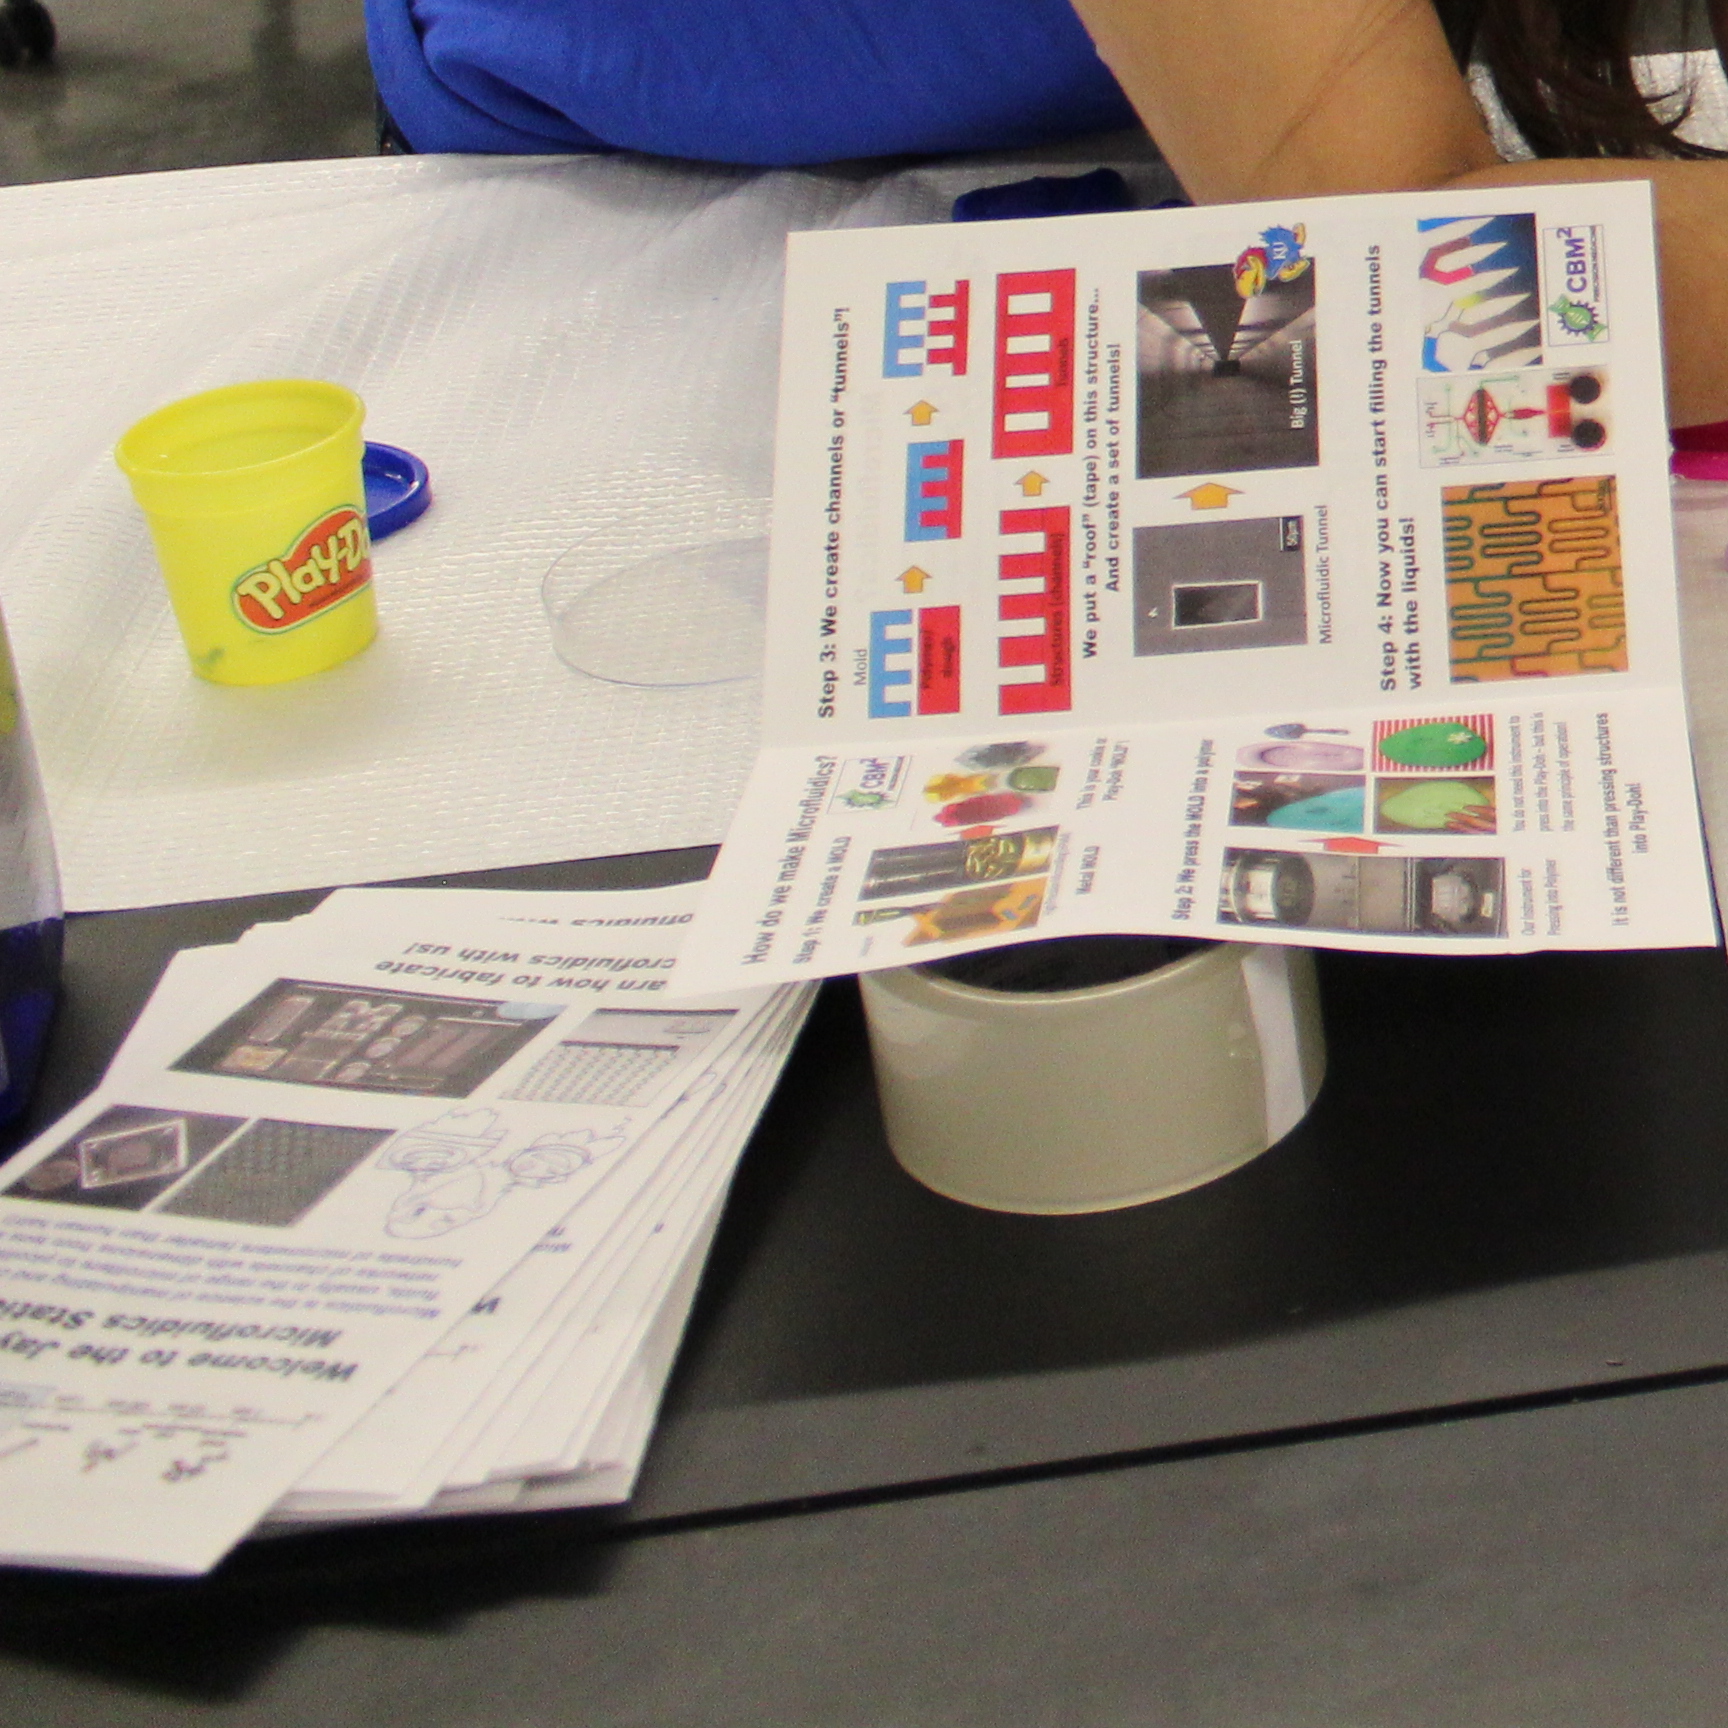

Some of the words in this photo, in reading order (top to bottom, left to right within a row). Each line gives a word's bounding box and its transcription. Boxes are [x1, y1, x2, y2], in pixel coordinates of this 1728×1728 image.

[1270, 240, 1288, 260] KU
[1365, 245, 1381, 315] tunnels
[1367, 322, 1382, 353] the
[1287, 339, 1303, 384] Tunnel
[1106, 344, 1120, 412] tunnels!
[1368, 359, 1387, 413] filling
[832, 409, 845, 428] or
[1083, 390, 1097, 422] this
[1289, 406, 1306, 428] Big
[1086, 428, 1097, 449] on
[1105, 419, 1119, 435] of
[1106, 441, 1119, 468] set
[1371, 419, 1386, 466] start
[825, 435, 843, 524] channels
[1082, 455, 1100, 507] (tape)
[1108, 474, 1119, 485] a
[1375, 473, 1388, 510] can
[1106, 491, 1119, 550] create
[1314, 504, 1328, 552] Tunnel
[1377, 517, 1394, 553] you
[236, 518, 371, 621] Play-D
[824, 531, 839, 598] create
[1399, 518, 1419, 592] liquids!
[1085, 573, 1096, 585] a
[1105, 556, 1119, 591] And
[1376, 561, 1392, 607] Now
[1083, 591, 1100, 622] put
[1316, 557, 1331, 643] Microfluidic
[820, 605, 837, 636] We
[1377, 615, 1393, 634] 4:
[1403, 600, 1419, 634] the
[819, 643, 836, 661] 3:
[1049, 609, 1063, 686] Structures
[1082, 628, 1097, 658] We
[853, 648, 868, 685] Mold
[1380, 641, 1398, 690] Step
[1404, 642, 1421, 687] with
[817, 669, 838, 717] Step
[1595, 712, 1612, 765] structures
[787, 756, 835, 842] Microfluidics?
[1189, 776, 1208, 793] into
[1599, 768, 1620, 812] pressing
[1185, 794, 1205, 821] MOLD
[1625, 782, 1646, 831] Play-Doh!
[1184, 822, 1201, 838] the
[1603, 814, 1619, 838] than
[826, 836, 851, 864] MOLD
[1081, 845, 1100, 869] MOLD
[1183, 839, 1200, 866] press
[1631, 833, 1648, 853] into
[777, 846, 805, 881] make
[1176, 867, 1195, 883] We
[1605, 840, 1624, 883] different
[770, 885, 791, 904] we
[816, 874, 838, 906] create
[1076, 870, 1094, 894] Metal
[1609, 885, 1626, 903] not
[756, 910, 783, 927] do
[806, 908, 827, 925] We
[1171, 896, 1195, 919] Step
[1611, 905, 1628, 915] is
[1612, 917, 1628, 925] It
[400, 941, 453, 955] us!
[456, 948, 520, 963] with
[743, 931, 774, 963] How
[792, 939, 820, 963] Step
[374, 960, 505, 985] fabricate
[529, 954, 676, 972] crofluidics
[512, 974, 541, 988] to
[555, 975, 610, 992] how
[616, 979, 667, 992] arn
[0, 1331, 61, 1361] Jay
[102, 1314, 342, 1349] Microfluidics
[67, 1344, 130, 1366] the
[139, 1350, 179, 1367] to
[187, 1353, 358, 1382] Welcome
